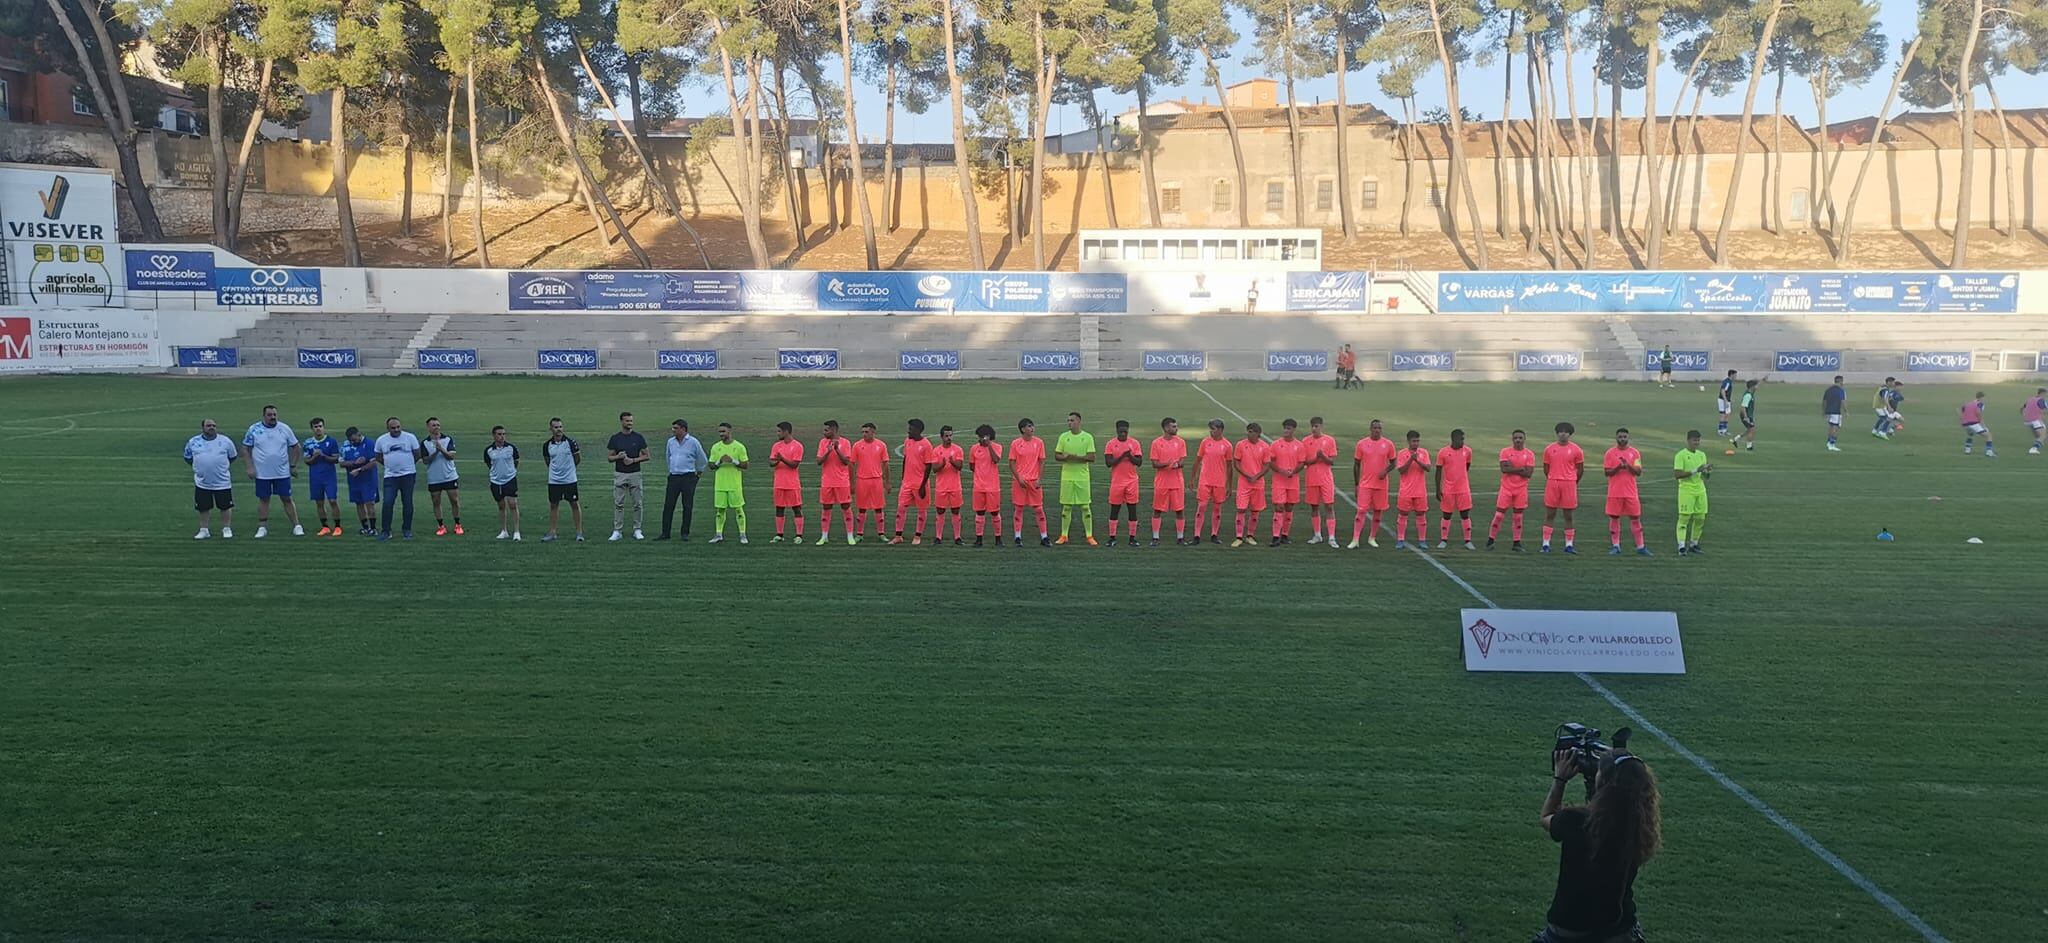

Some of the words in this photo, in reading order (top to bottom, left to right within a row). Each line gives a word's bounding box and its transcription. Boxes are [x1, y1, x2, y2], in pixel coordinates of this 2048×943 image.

[8, 221, 104, 240] VISEVER
[46, 273, 96, 284] agrícola
[588, 272, 615, 280] adamo
[38, 283, 105, 294] villarrobledo
[847, 287, 890, 296] COLLADO
[1292, 288, 1361, 299] SERICAMAN
[1464, 289, 1515, 298] VARGAS
[221, 293, 318, 304] CONTRERAS
[1768, 296, 1811, 310] JUANITO
[619, 302, 634, 310] 900
[635, 302, 647, 310] 651
[648, 302, 661, 310] 601
[38, 319, 100, 329] Estructuras
[38, 329, 72, 340] Calero
[74, 329, 129, 341] Montejano
[39, 343, 94, 352] ESTRCTURAS
[96, 343, 106, 351] EN
[107, 341, 148, 351] HORMIGÓN
[1588, 635, 1674, 645] VILLARROBLEDO
